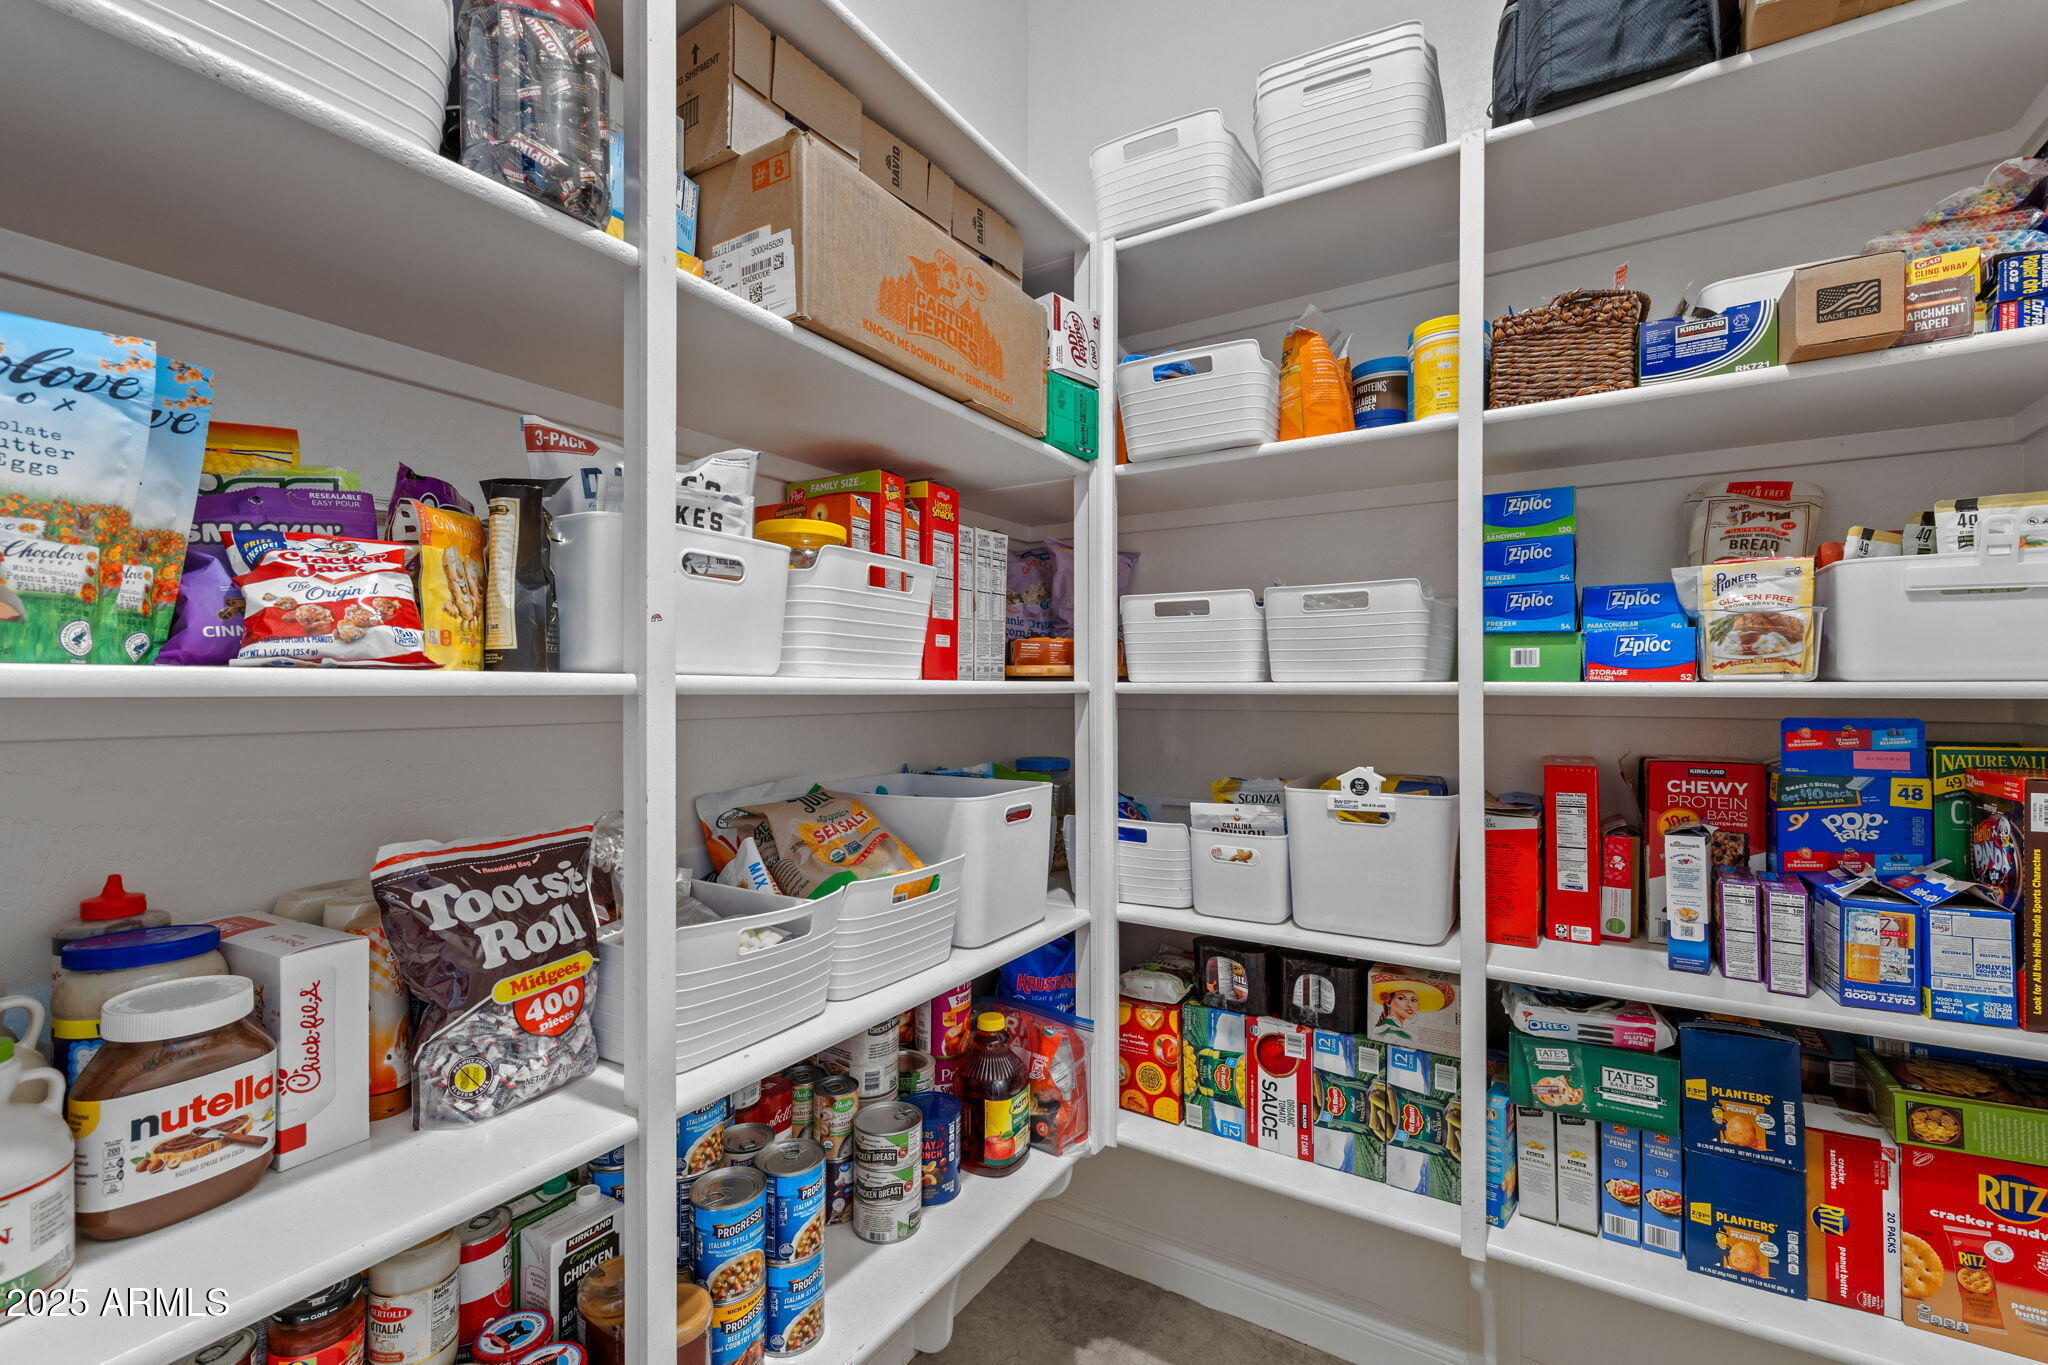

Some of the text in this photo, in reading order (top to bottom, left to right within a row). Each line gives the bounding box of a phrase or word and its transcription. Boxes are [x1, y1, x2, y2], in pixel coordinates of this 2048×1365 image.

[685, 53, 720, 84] SHIPMENT
[891, 145, 900, 189] DAVID
[1915, 256, 1942, 269] GLAD
[1915, 261, 1968, 279] CLING WRAP
[914, 286, 976, 341] CARTON
[1819, 305, 1880, 323] MADE IN USA
[1906, 303, 1966, 322] ARCHMENT
[1679, 320, 1725, 334] KIRKLAND
[1914, 317, 1949, 332] PAPER
[906, 303, 980, 368] HEROES
[862, 318, 895, 345] KNOCK
[896, 337, 910, 351] ME
[911, 344, 937, 366] DOWN
[939, 360, 956, 376] FLAT
[965, 372, 982, 389] SEND
[1735, 360, 1771, 373] RK721
[1357, 380, 1388, 396] PROTEINS
[534, 429, 588, 450] 3-PACK
[810, 477, 860, 492] FAMILY SIZE
[309, 491, 361, 501] RESEALABLE
[1764, 489, 1785, 497] FREE
[311, 500, 361, 508] EASY POUR
[1508, 496, 1552, 515] Ziploc
[243, 538, 272, 551] PRIZE
[1486, 532, 1526, 541] SANDWICH
[1729, 538, 1779, 552] BREAD
[246, 542, 279, 565] INSIDE!
[277, 551, 389, 566] Cracker
[1508, 545, 1552, 564] Ziploc
[6, 570, 82, 587] Peanut Butter
[295, 563, 368, 579] Jack
[16, 581, 56, 595] Filled
[287, 581, 310, 593] The
[1715, 572, 1758, 597] PIONEER
[1509, 592, 1553, 611] Ziploc
[1611, 590, 1660, 610] Ziploc
[1764, 594, 1795, 604] FREE
[1618, 637, 1672, 657] Ziploc
[1680, 673, 1692, 681] 52
[1941, 754, 2008, 773] NATURE
[1666, 780, 1749, 796] CHEWY
[1945, 776, 1963, 789] 49
[1238, 793, 1281, 804] SCONZA
[1667, 794, 1748, 810] PROTEIN
[1897, 787, 1924, 801] 48
[799, 791, 834, 814] JULY
[1707, 810, 1748, 822] BARS
[812, 810, 871, 845] SEA SALT
[1222, 822, 1253, 830] CATALINA
[748, 861, 769, 890] MIX
[474, 902, 587, 970] Roll
[2033, 848, 2043, 1015] Look for All the Hello Panda Sports Characters
[508, 960, 582, 996] Midgees
[525, 985, 579, 1022] 400
[538, 1010, 576, 1033] pieces
[1528, 1020, 1570, 1031] OREO
[1318, 1038, 1331, 1051] 12
[1623, 1035, 1655, 1043] GLUTEN
[1394, 1053, 1408, 1067] 12
[1537, 1049, 1567, 1058] TATE'S
[1604, 1069, 1655, 1089] TATE'S
[1610, 1081, 1650, 1093] BAKE SHOP
[1711, 1085, 1771, 1105] PLANTERS
[130, 1073, 274, 1143] nutella
[1261, 1079, 1279, 1140] SAUCE
[1287, 1099, 1295, 1128] ORGANIC
[1229, 1125, 1240, 1137] 12
[1609, 1139, 1632, 1149] PENNE
[872, 1153, 896, 1161] BREAST
[1650, 1148, 1673, 1158] PENNE
[1520, 1156, 1552, 1168] MACARONI
[1560, 1165, 1594, 1177] MACARONI
[878, 1187, 902, 1198] BREAST
[1978, 1174, 2048, 1218] RITZ
[716, 1207, 763, 1239] PROGRESSO
[1715, 1211, 1776, 1234] PLANTERS
[1818, 1203, 1846, 1237] RITZ
[1929, 1209, 1994, 1229] cracker
[568, 1217, 612, 1248] KIRKLAND
[1730, 1232, 1762, 1243] PEANUTS
[1886, 1211, 1897, 1254] 20 PACKS
[569, 1237, 609, 1265] Organic
[1958, 1251, 1987, 1267] RITZ
[563, 1247, 614, 1287] CHICKEN
[1837, 1246, 1849, 1299] peanut butter
[310, 1310, 330, 1321] CLOSE
[370, 1306, 408, 1319] BERTOLLI
